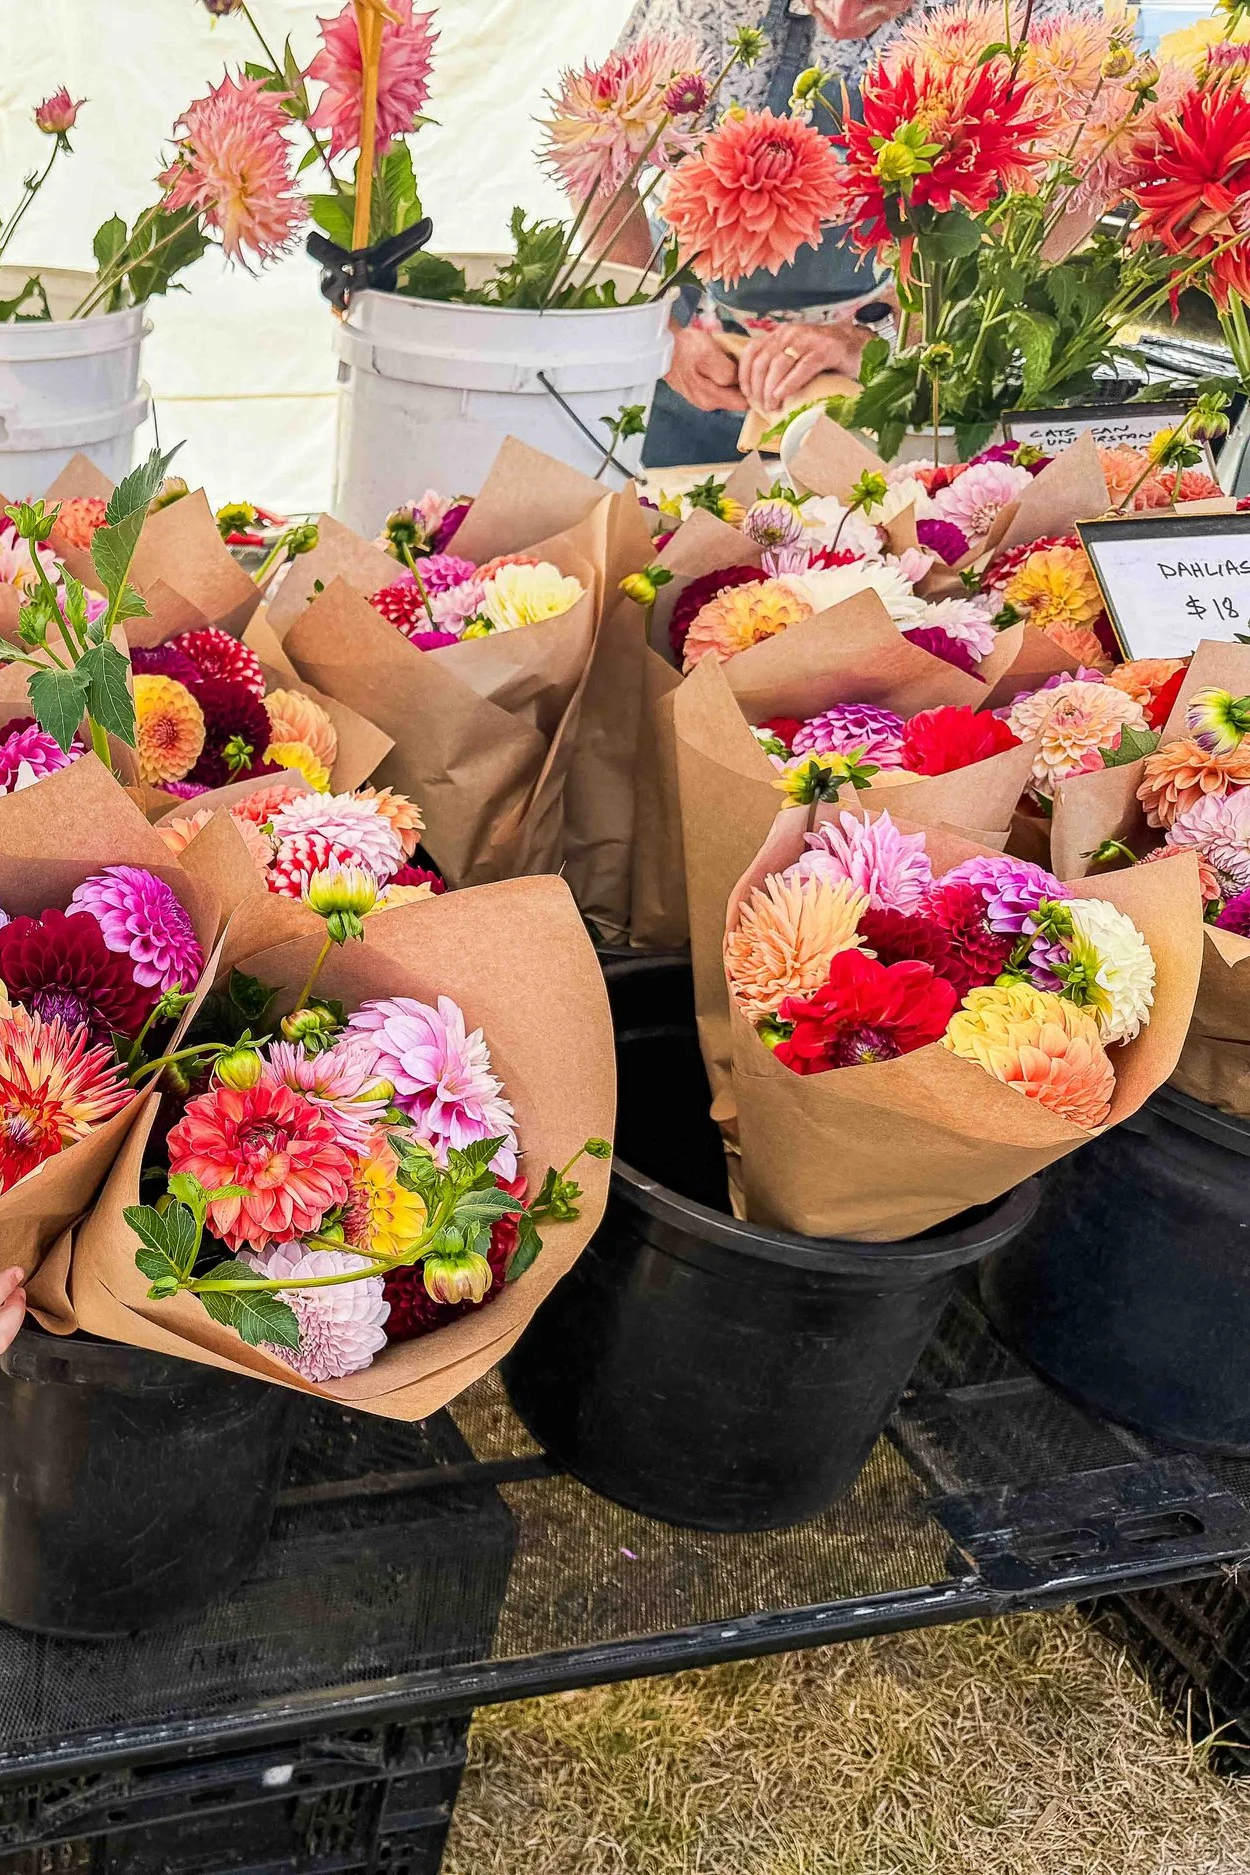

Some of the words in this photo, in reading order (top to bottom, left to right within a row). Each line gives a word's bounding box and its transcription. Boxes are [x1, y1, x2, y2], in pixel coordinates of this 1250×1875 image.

[1029, 427, 1076, 438] CATS
[1090, 425, 1129, 435] CAN
[1156, 559, 1250, 579] DAHLIAS
[1185, 594, 1240, 621] $18
